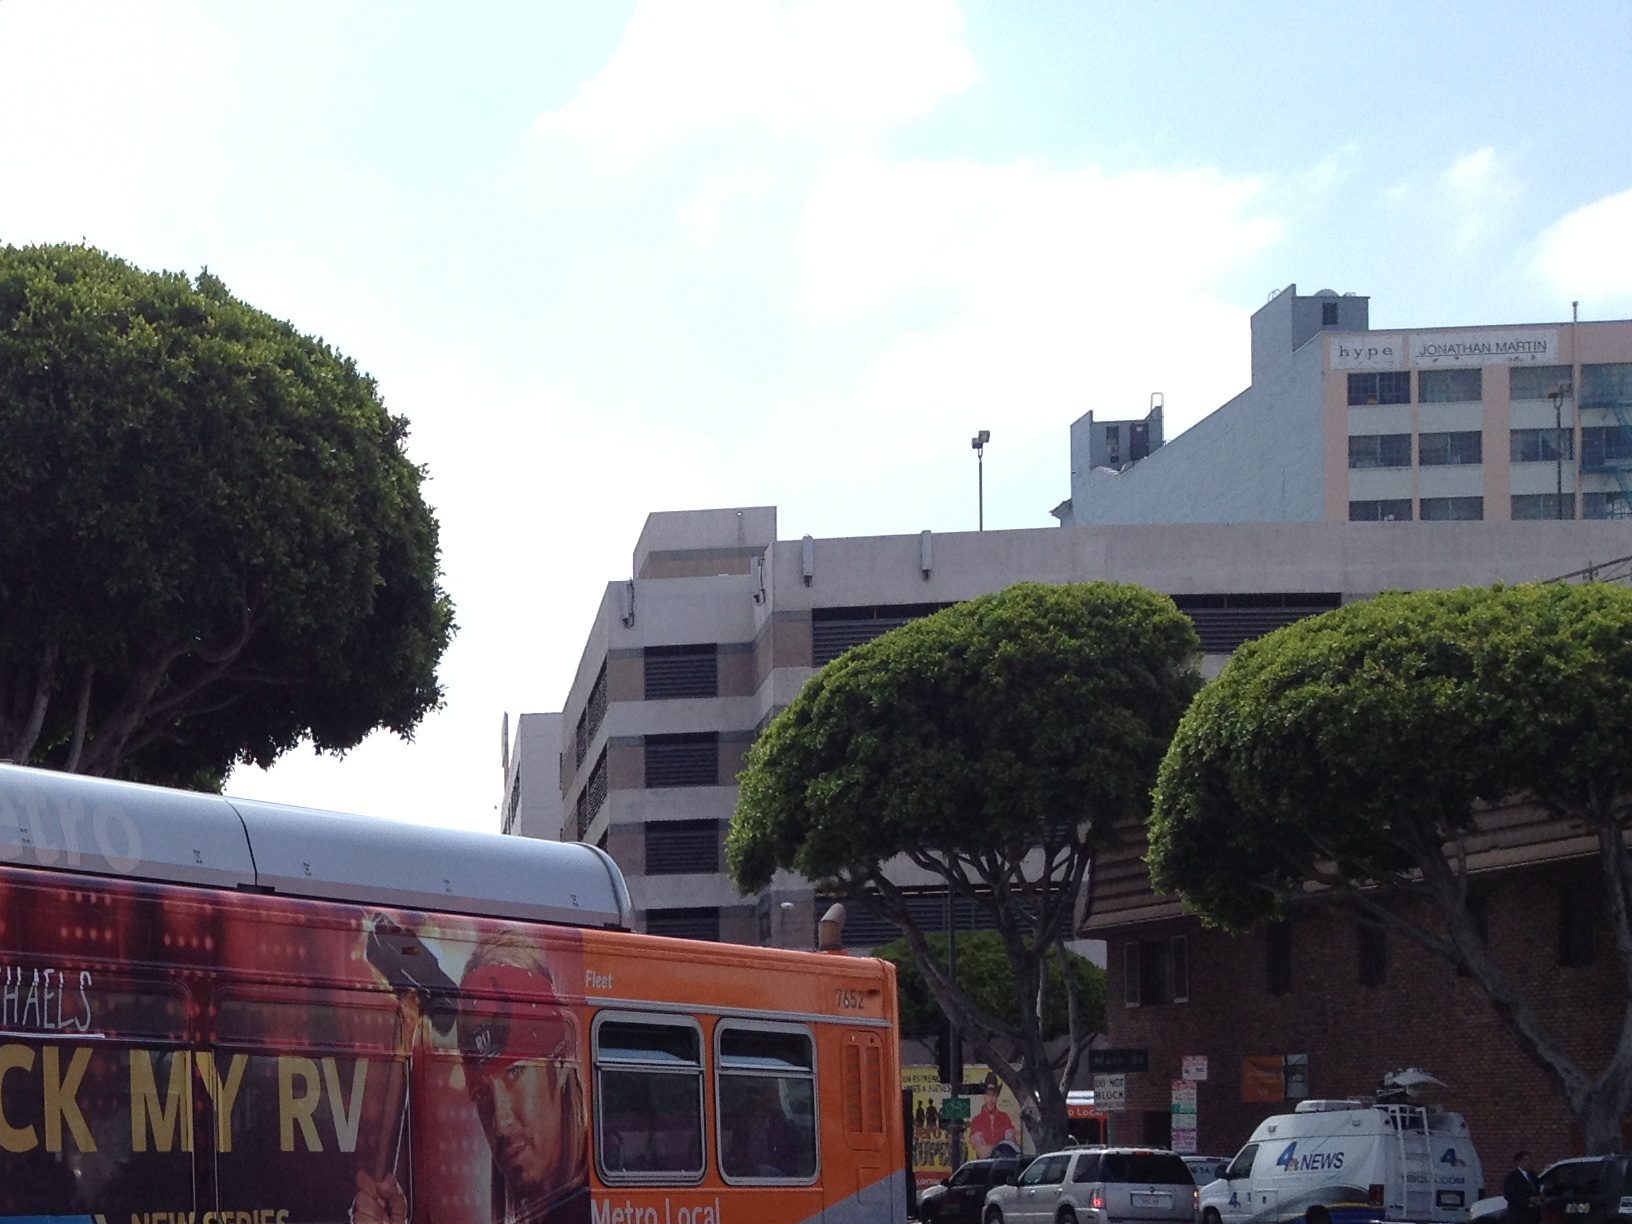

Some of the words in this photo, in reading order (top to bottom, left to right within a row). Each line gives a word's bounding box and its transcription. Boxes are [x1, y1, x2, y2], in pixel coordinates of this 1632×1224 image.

[1338, 345, 1393, 360] hype
[1419, 343, 1491, 356] JONATHAN
[1496, 340, 1547, 354] MARTIN
[585, 970, 613, 990] Fleet
[837, 988, 865, 1010] 7652
[1095, 1079, 1106, 1088] DO
[1109, 1078, 1124, 1088] NOT
[130, 1049, 249, 1153] MY
[278, 1056, 368, 1153] RV
[1095, 1091, 1124, 1100] BLOCK
[1276, 1141, 1298, 1171] 4
[1300, 1152, 1345, 1171] NEWS
[1440, 1148, 1458, 1167] 4
